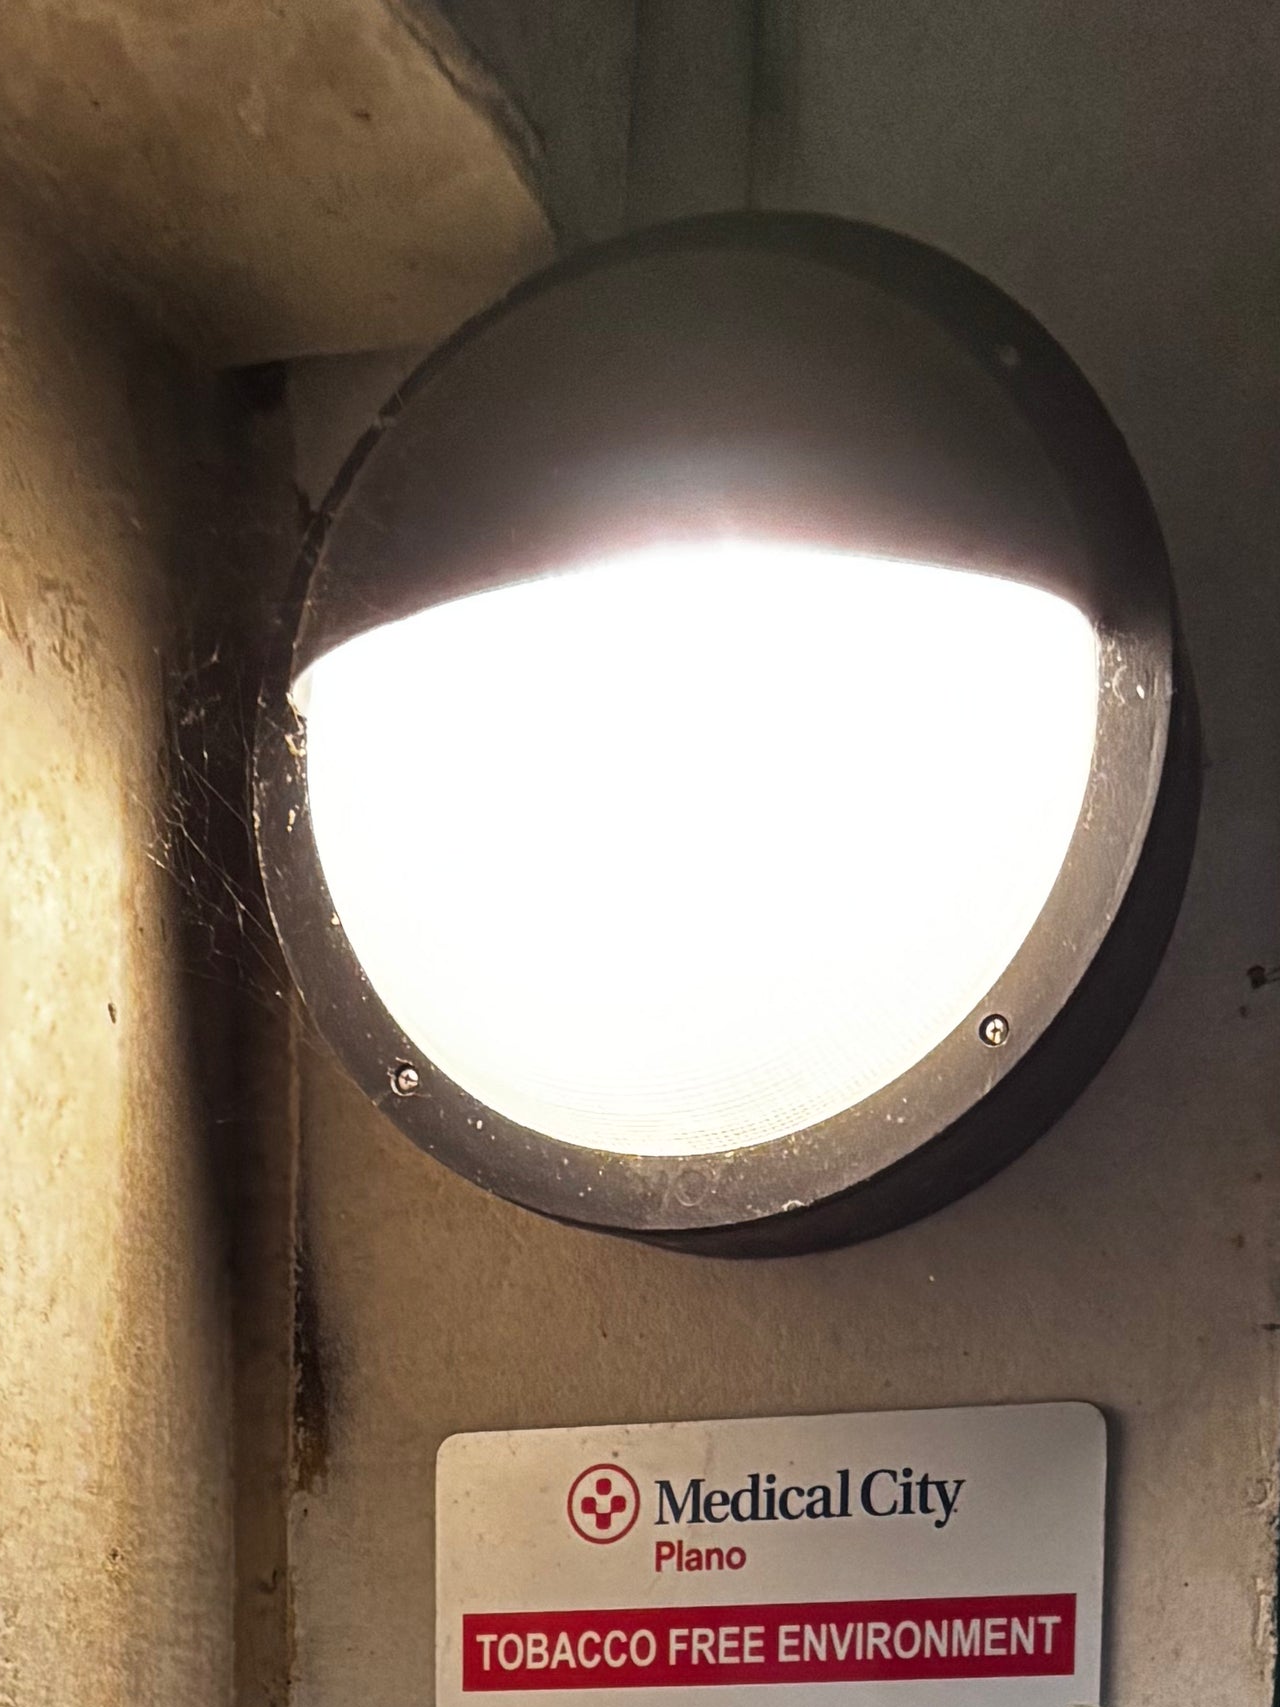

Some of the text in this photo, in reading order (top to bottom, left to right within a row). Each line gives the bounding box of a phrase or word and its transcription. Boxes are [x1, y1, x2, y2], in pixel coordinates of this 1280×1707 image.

[654, 1467, 966, 1529] Medical City
[655, 1540, 747, 1573] Plano
[476, 1616, 1062, 1671] TOBACCO FREE ENVIRONMENT
